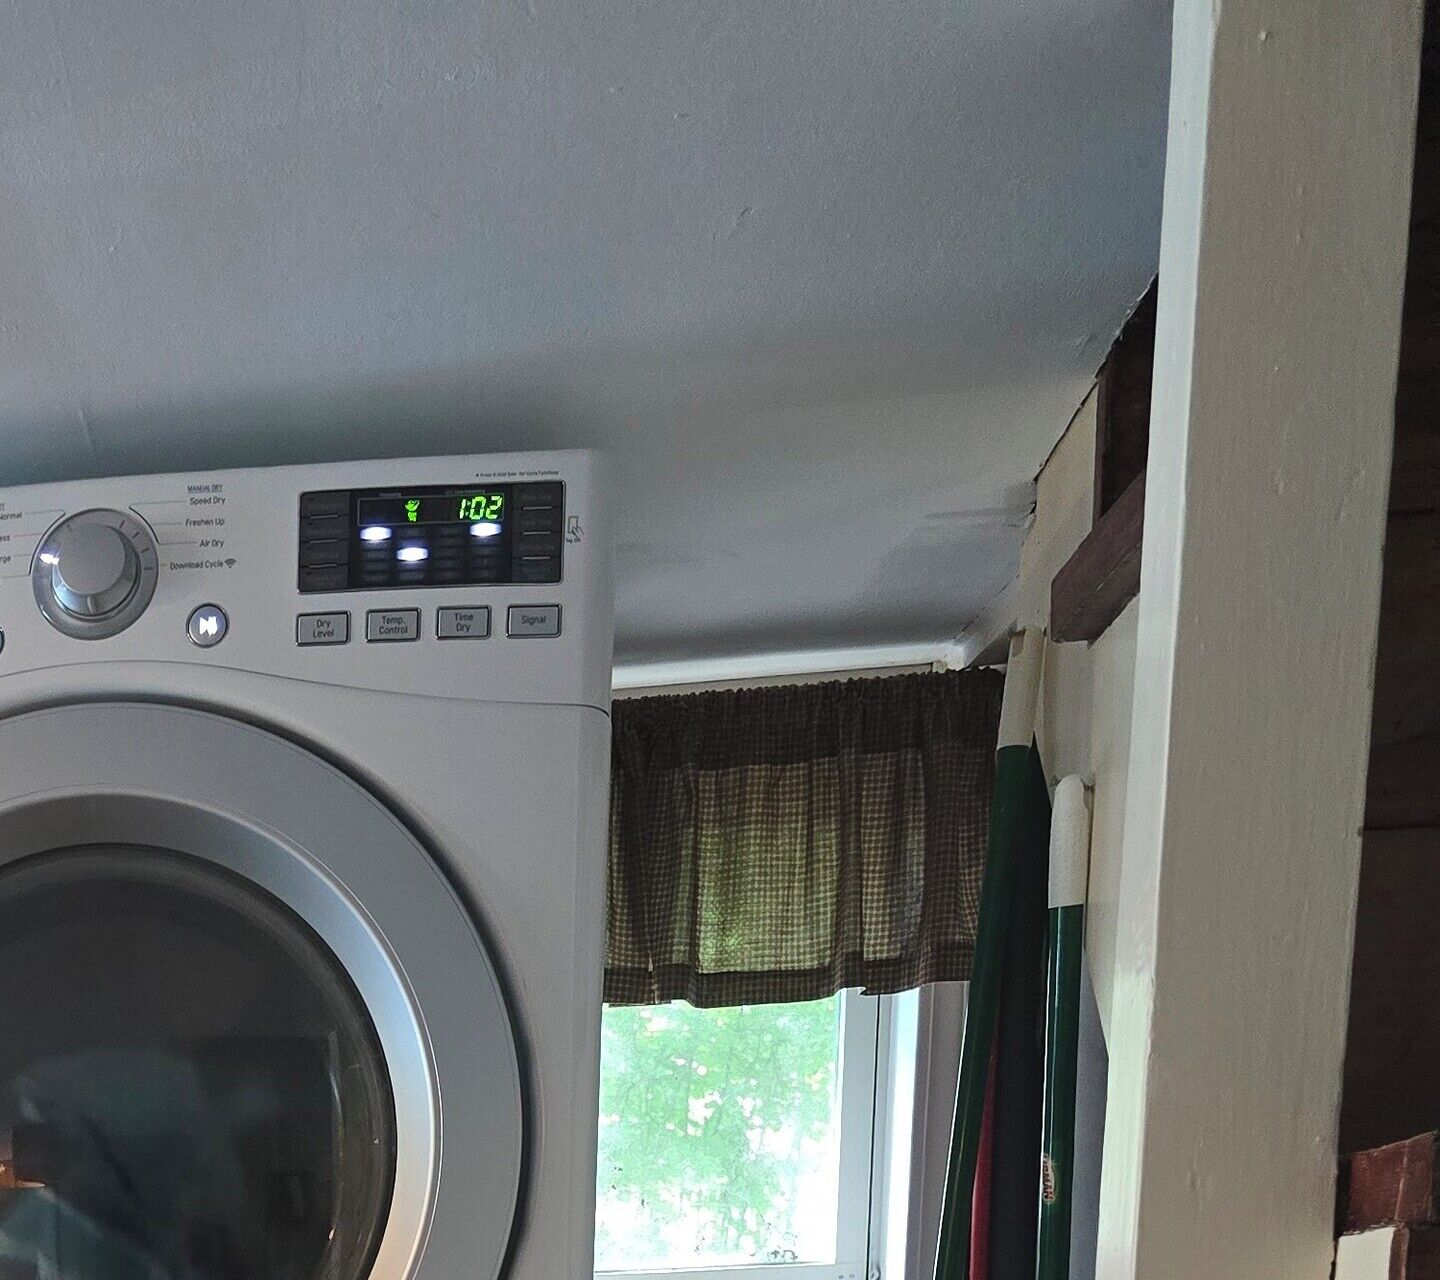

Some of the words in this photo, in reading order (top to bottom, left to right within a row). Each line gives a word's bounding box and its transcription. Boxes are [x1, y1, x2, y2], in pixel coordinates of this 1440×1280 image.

[190, 497, 212, 505] Speed
[213, 496, 226, 505] Dry
[459, 494, 503, 520] 1:02
[185, 519, 214, 527] Freshen
[215, 518, 225, 526] Up
[170, 561, 203, 570] Download
[205, 560, 224, 569] Cycle
[454, 613, 474, 622] Time
[522, 615, 546, 625] Signal
[317, 619, 332, 629] Dry
[456, 623, 471, 632] Dry
[313, 629, 334, 638] Level
[379, 625, 408, 634] Control
